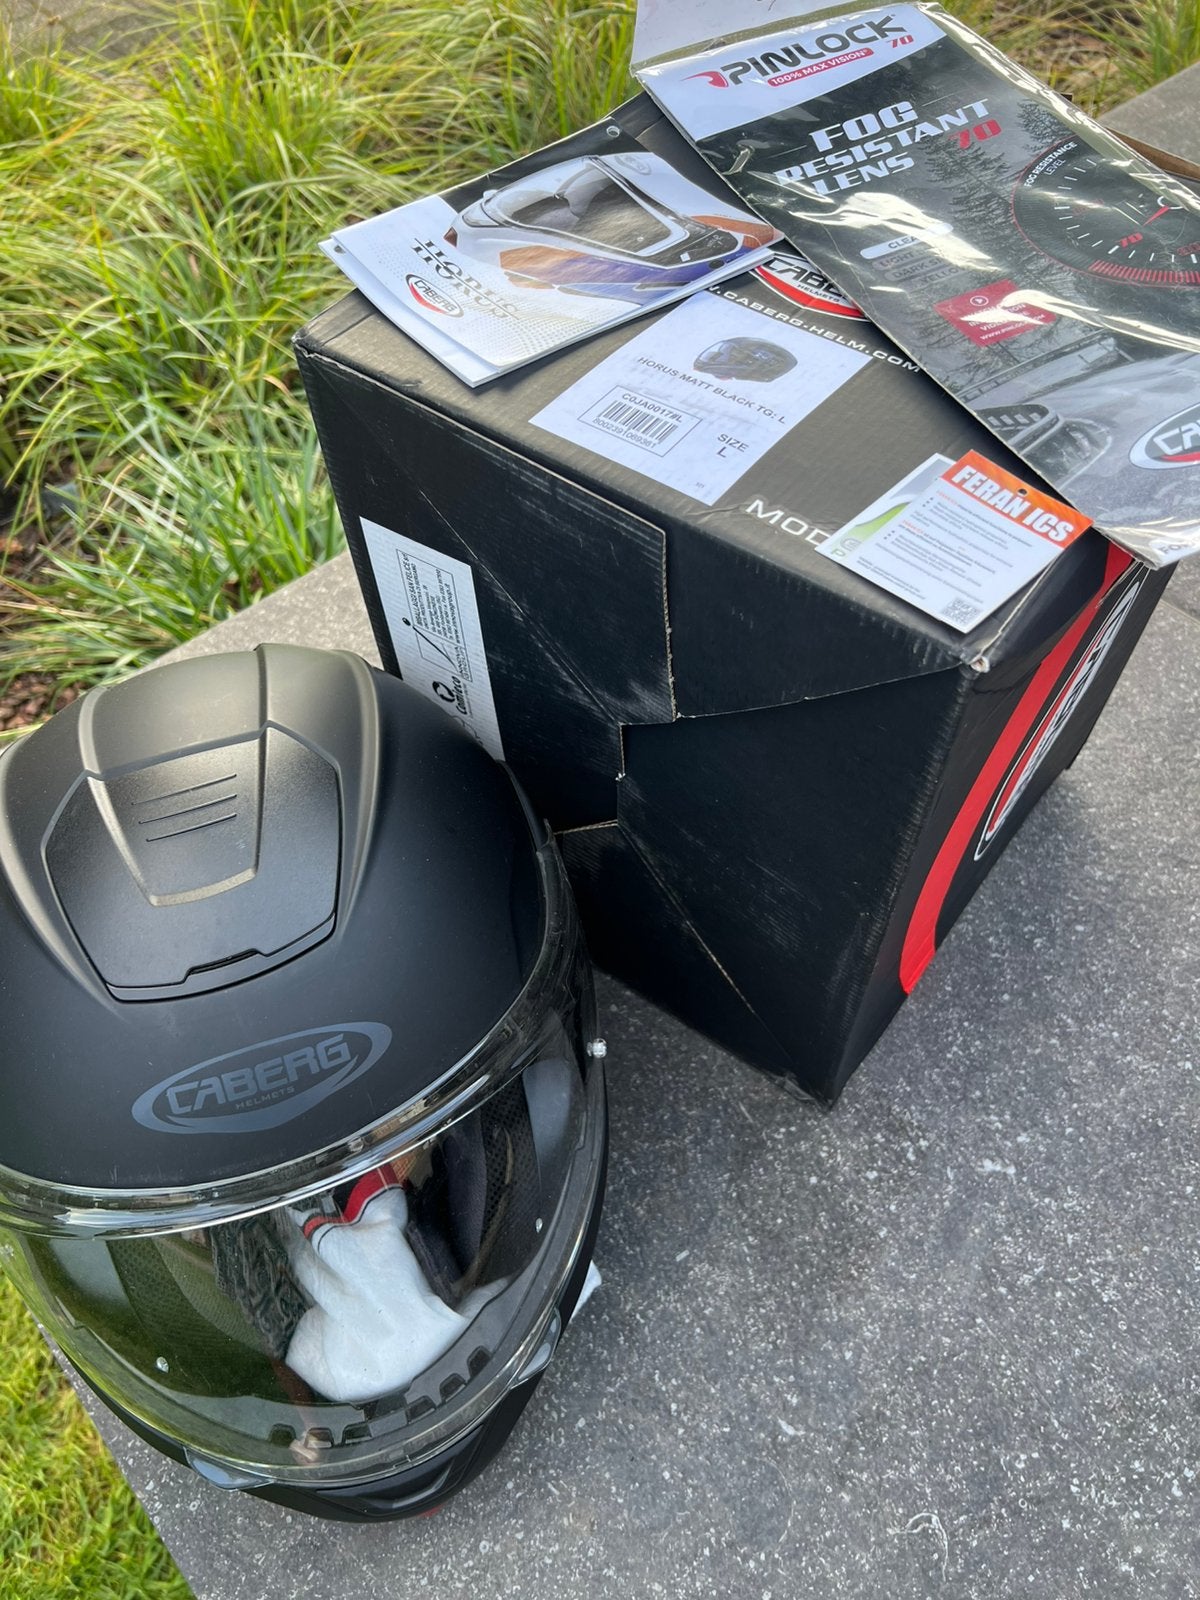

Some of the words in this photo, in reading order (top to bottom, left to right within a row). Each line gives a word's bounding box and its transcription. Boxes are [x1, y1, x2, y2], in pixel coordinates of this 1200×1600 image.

[720, 15, 907, 85] PINLOCK
[886, 35, 914, 49] 70
[771, 72, 802, 86] 100%
[802, 63, 828, 76] MAX
[809, 101, 918, 152] FOG
[774, 99, 989, 185] RESISTANT
[949, 119, 1002, 149] 70
[1034, 141, 1078, 175] RESISTANCE
[1044, 158, 1066, 176] LEVEL
[812, 152, 915, 195] LENS
[888, 235, 917, 249] CLEA
[1115, 232, 1144, 248] 70
[880, 252, 914, 267] LIGHT
[892, 262, 928, 279] DARK
[414, 279, 458, 312] CABERG
[637, 356, 679, 377] HORUS
[679, 373, 714, 390] MATT
[713, 386, 757, 408] BLACK
[756, 404, 777, 420] TG:
[778, 415, 787, 425] L
[717, 433, 749, 453] SIZE
[1153, 420, 1200, 455] CA
[717, 446, 728, 458] L
[951, 464, 1032, 519] FERAN
[1022, 512, 1075, 543] ICS
[167, 1033, 351, 1115] CABERG
[235, 1086, 295, 1110] HELMETS
